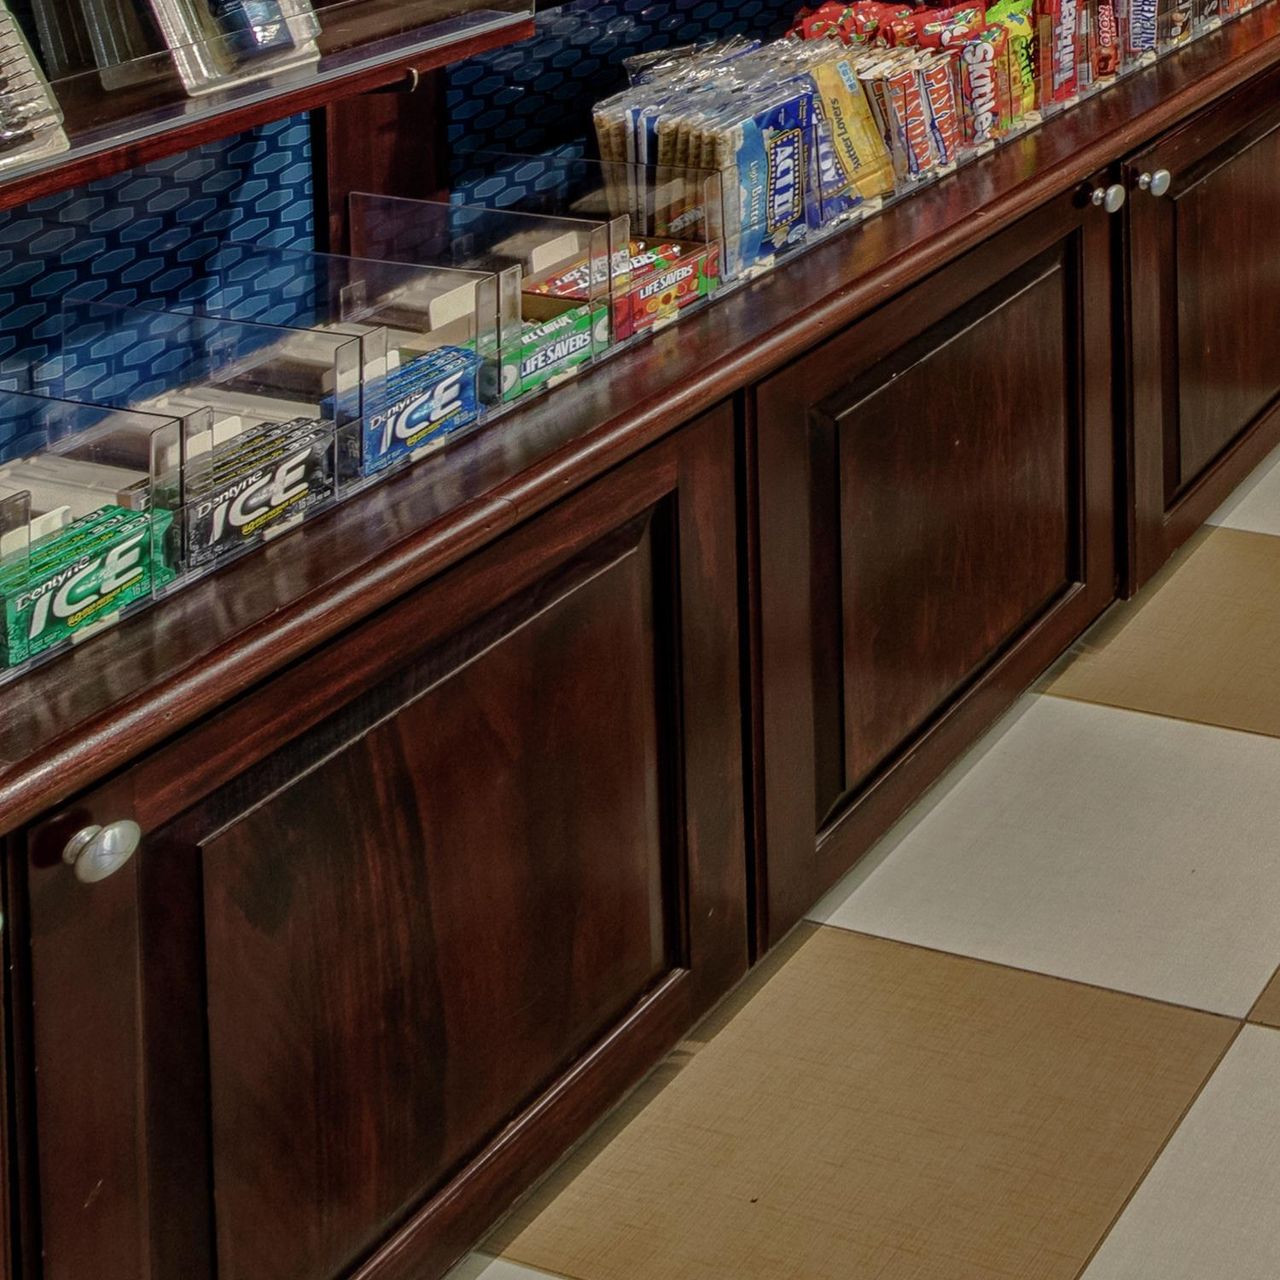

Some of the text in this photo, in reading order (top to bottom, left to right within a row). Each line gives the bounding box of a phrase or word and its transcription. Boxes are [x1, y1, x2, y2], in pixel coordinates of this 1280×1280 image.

[831, 97, 850, 137] Lovers
[926, 65, 959, 161] PAYDAY
[963, 41, 997, 144] Skittles
[751, 184, 763, 230] Butter
[774, 146, 795, 219] ACT II
[378, 370, 464, 456] ICE
[197, 470, 263, 519] Dentyne
[209, 447, 312, 546] ICE
[15, 555, 91, 612] Dentyne
[29, 528, 147, 640] ICE
